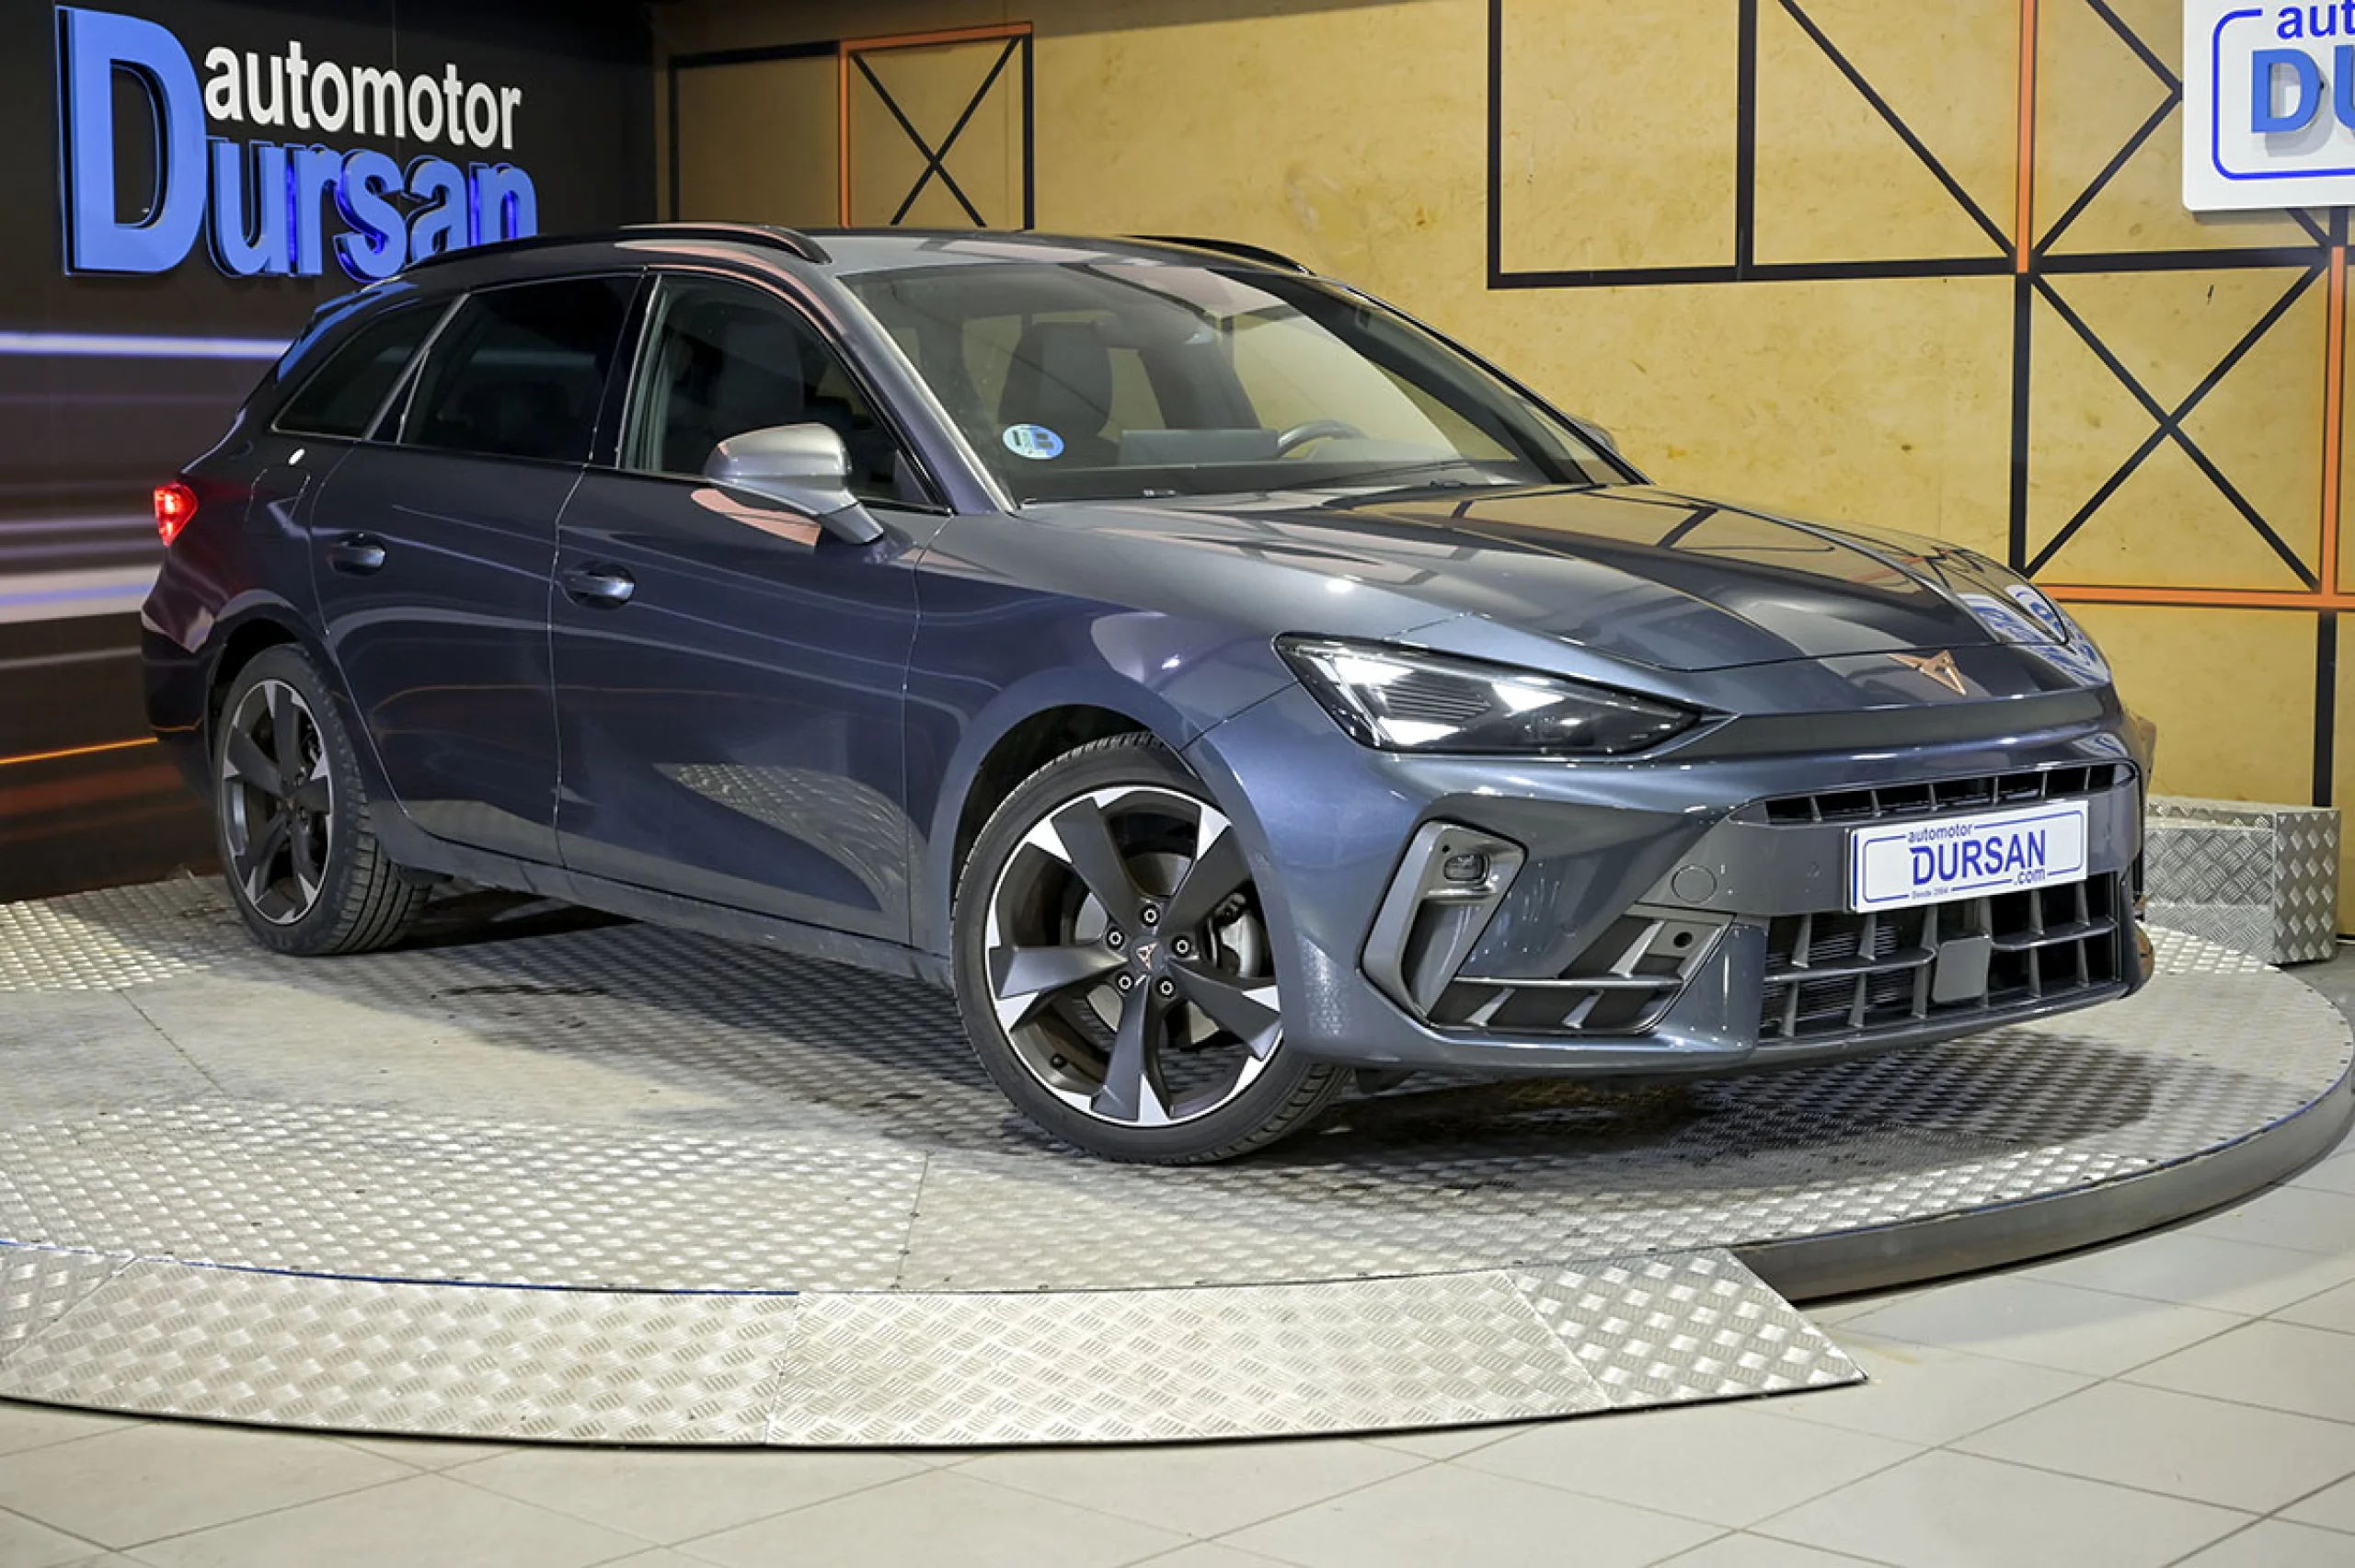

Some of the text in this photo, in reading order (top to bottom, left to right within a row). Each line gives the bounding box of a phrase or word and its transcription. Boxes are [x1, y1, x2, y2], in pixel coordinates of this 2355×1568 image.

[205, 40, 522, 150] automotor
[56, 6, 539, 282] Dursan
[1908, 824, 1973, 843] automotor
[1909, 830, 2046, 886] DURSAN
[2013, 868, 2046, 886] .com
